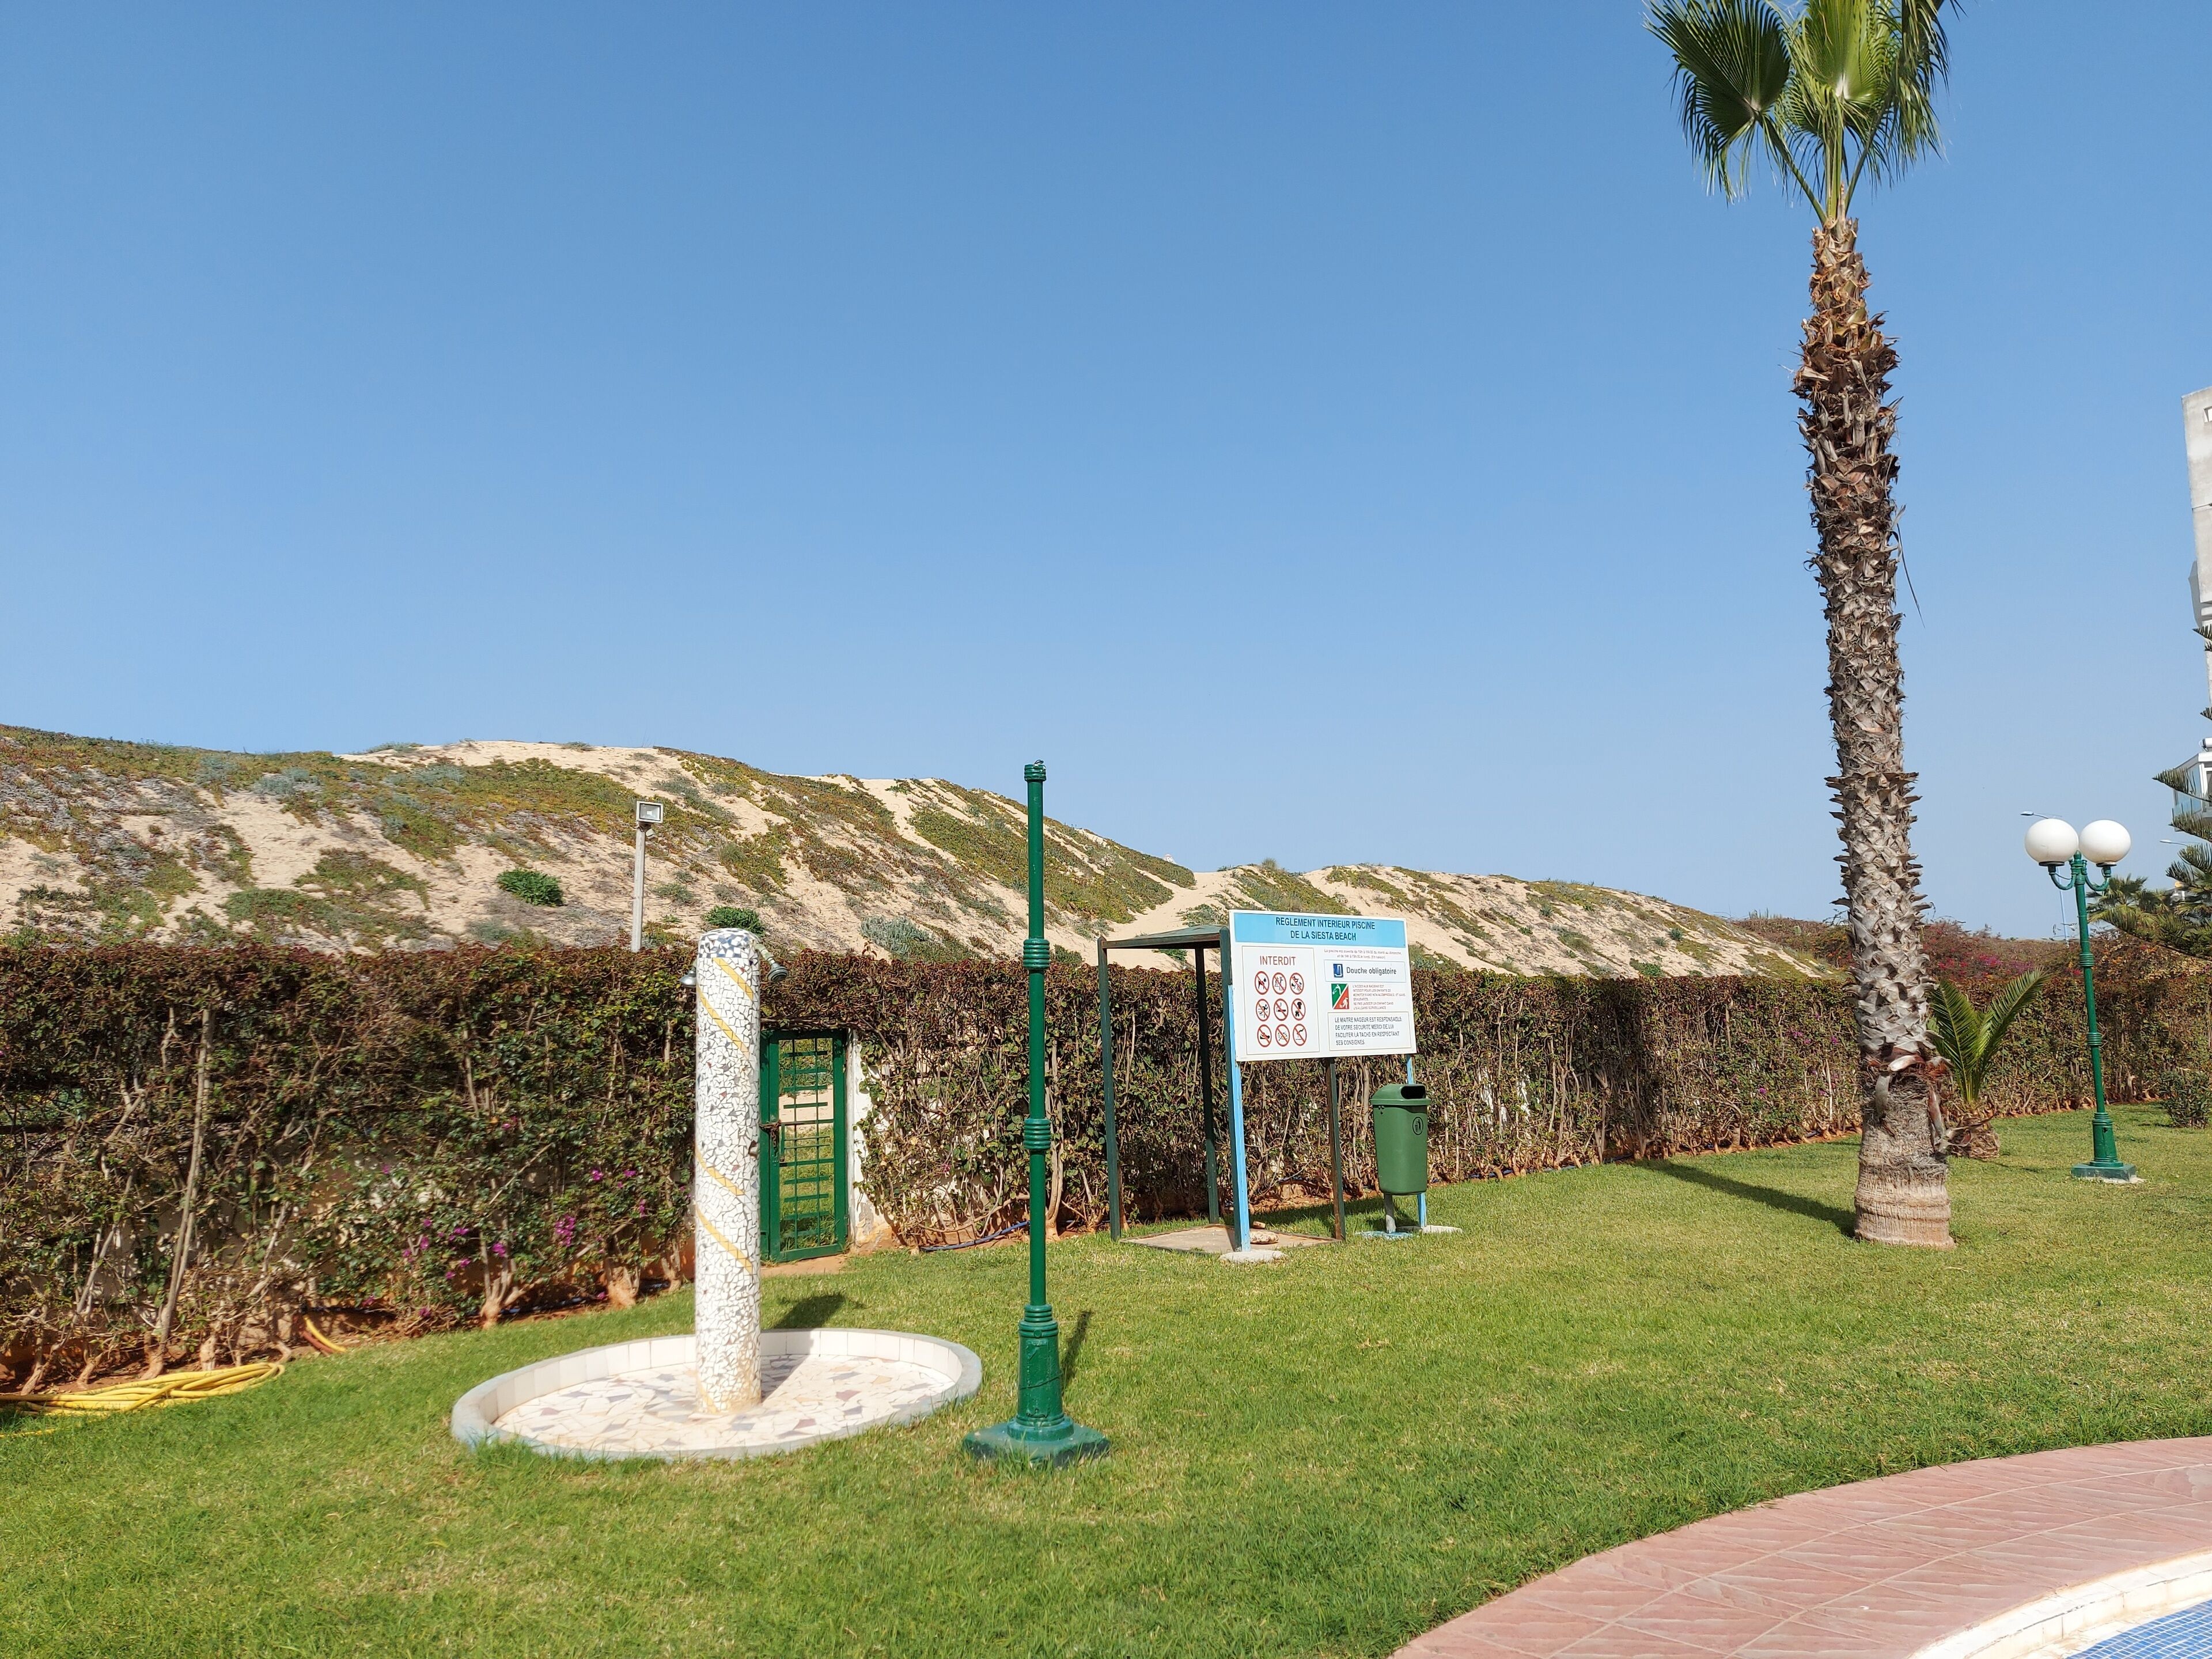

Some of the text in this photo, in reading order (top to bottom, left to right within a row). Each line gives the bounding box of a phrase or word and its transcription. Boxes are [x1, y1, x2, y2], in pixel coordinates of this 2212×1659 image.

[1276, 917, 1375, 929] REGLEMENT INTERIEUR PISCINE
[1291, 930, 1356, 941] DE LA SIESTA BEACH
[1260, 956, 1296, 965] INTERDIT
